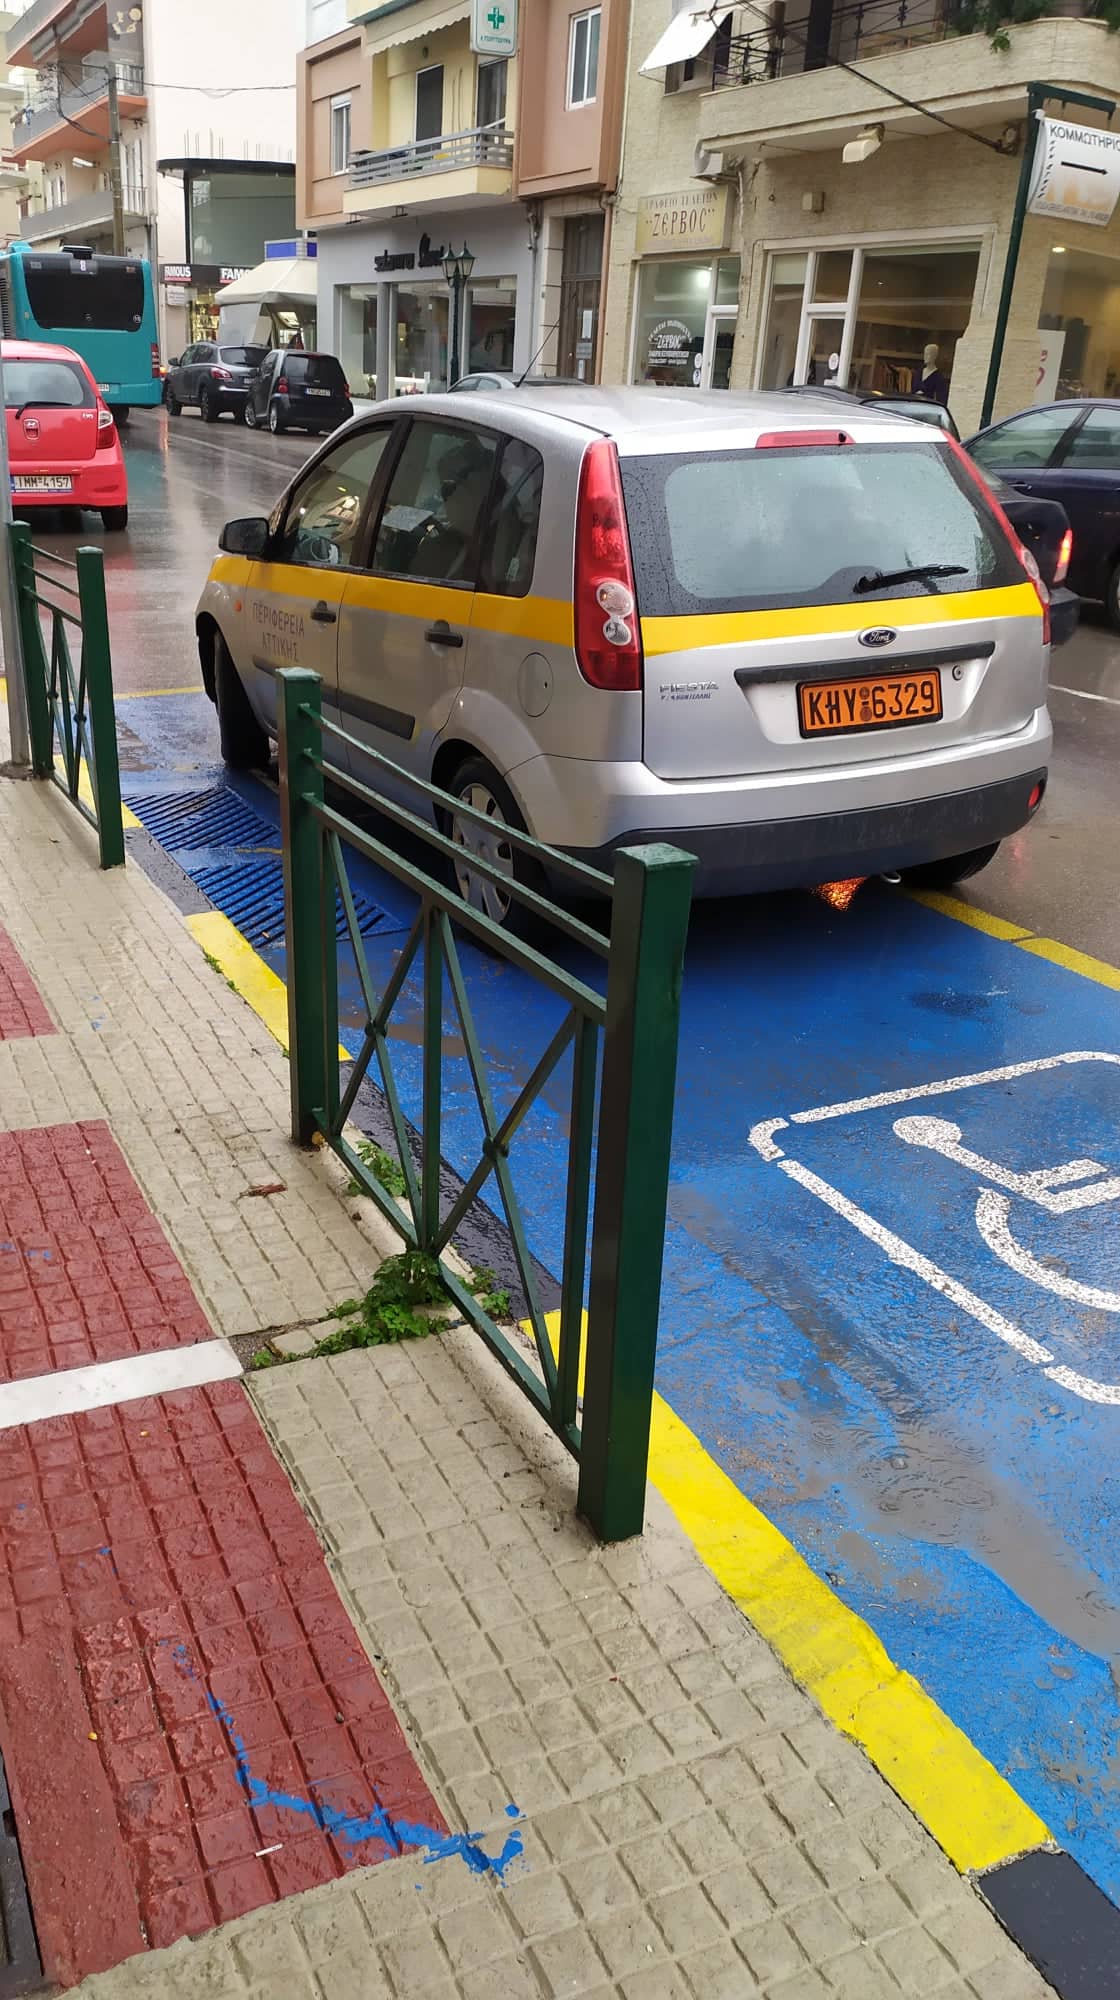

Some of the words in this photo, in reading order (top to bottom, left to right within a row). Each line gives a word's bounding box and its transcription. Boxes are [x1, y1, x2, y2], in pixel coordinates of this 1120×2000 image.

[164, 265, 192, 277] FAMOUS
[252, 602, 305, 638] ΠΕΡΙΦΕΡΕΙΑ
[868, 629, 890, 643] Ford
[262, 631, 299, 662] ΑΤΤΙΚΗΣ
[659, 681, 719, 693] FIESTA
